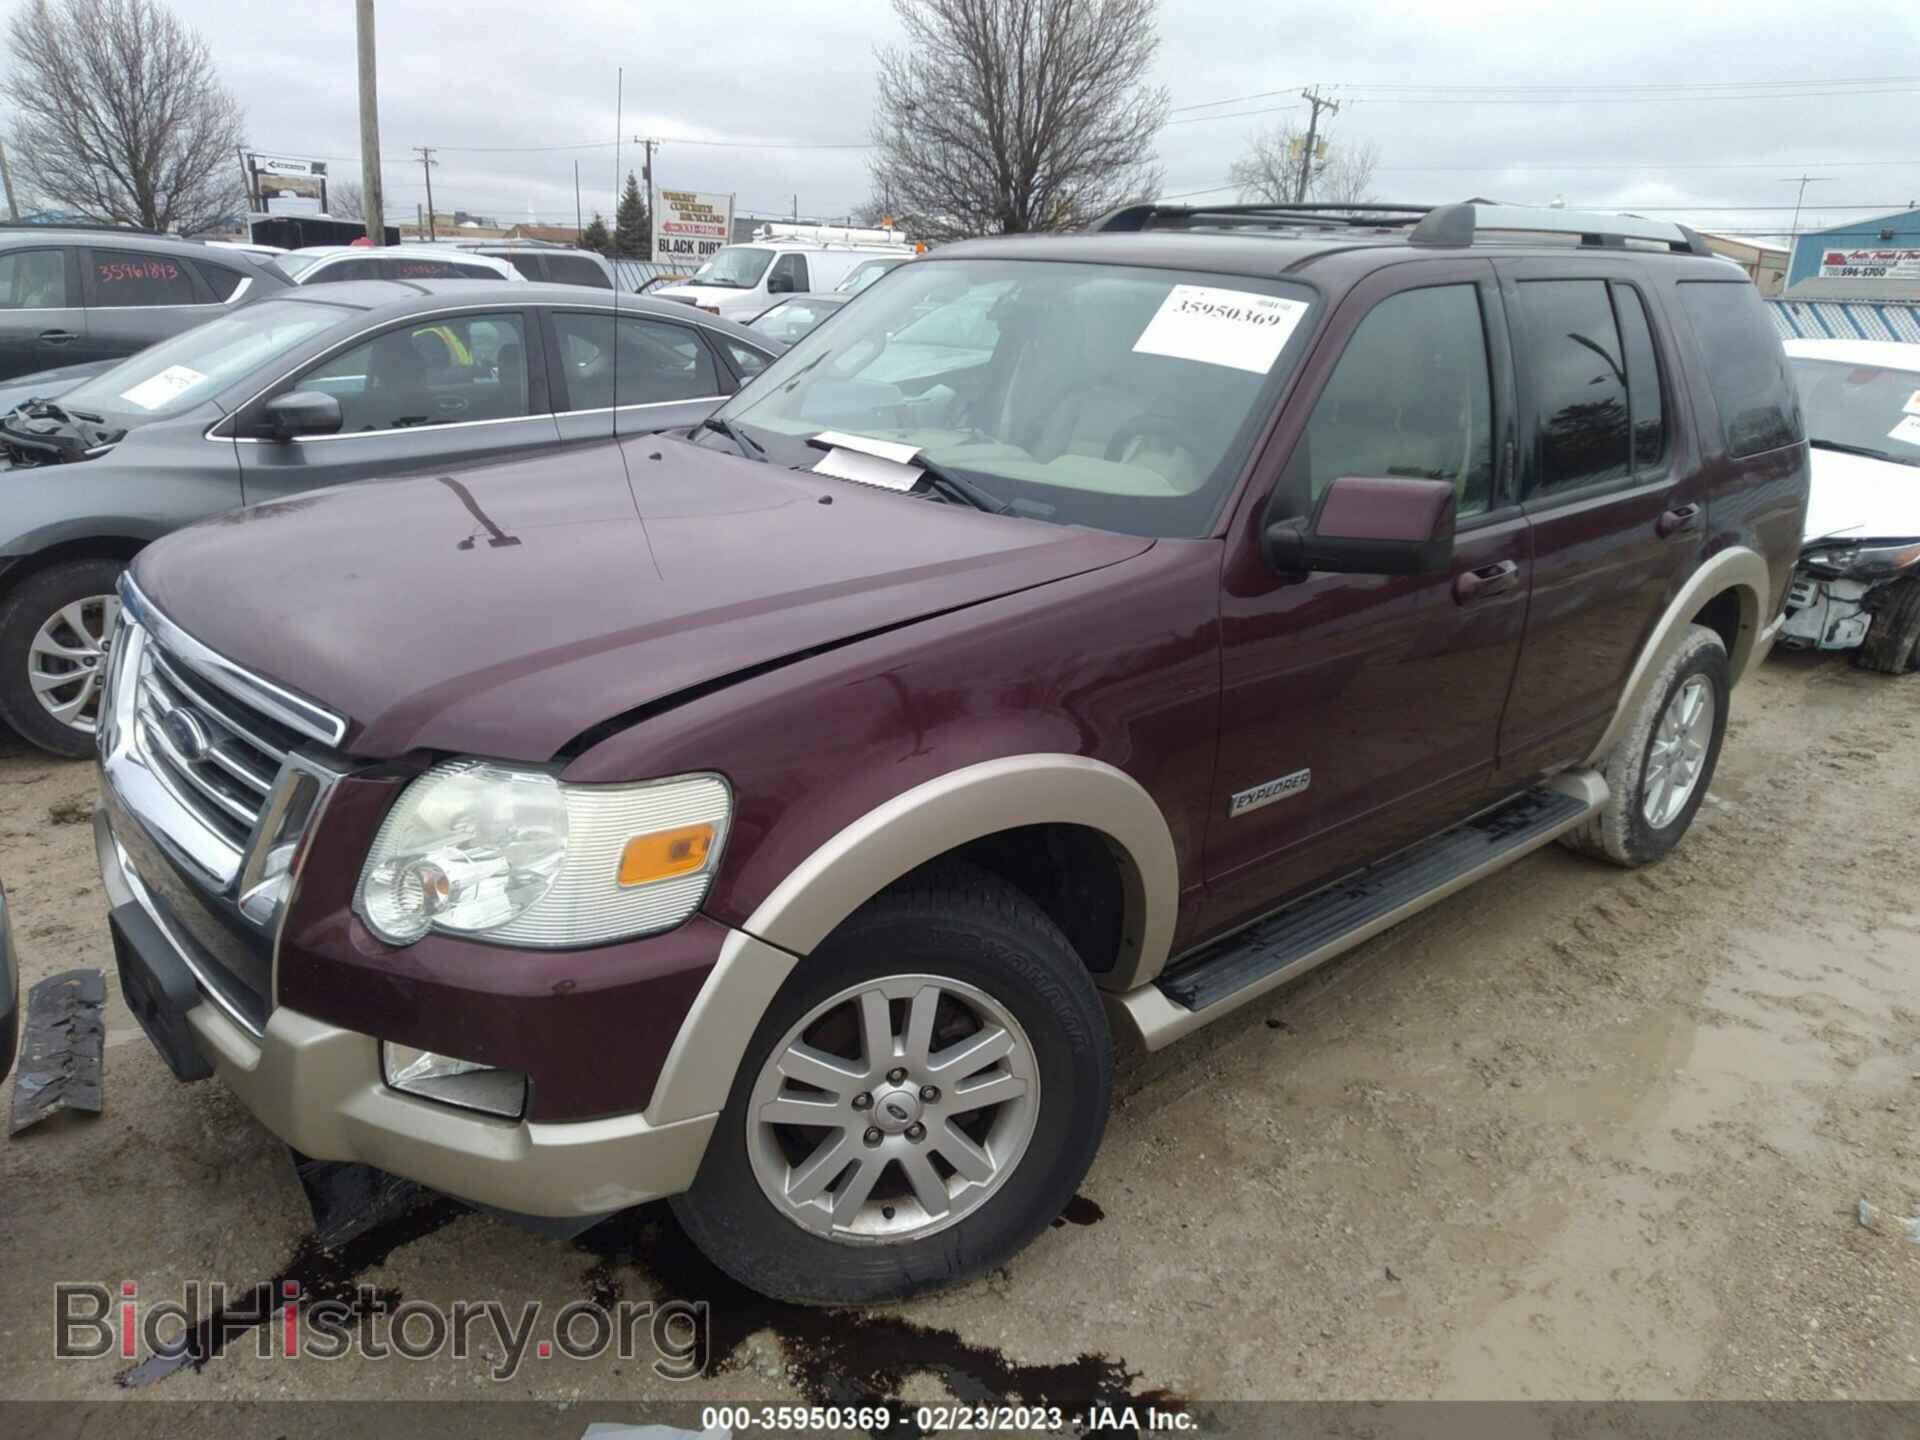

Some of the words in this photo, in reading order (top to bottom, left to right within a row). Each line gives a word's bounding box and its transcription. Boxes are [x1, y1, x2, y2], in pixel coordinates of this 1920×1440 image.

[658, 239, 695, 254] BLACK
[1173, 300, 1281, 326] 35950369
[1234, 772, 1309, 808] EXPLORER
